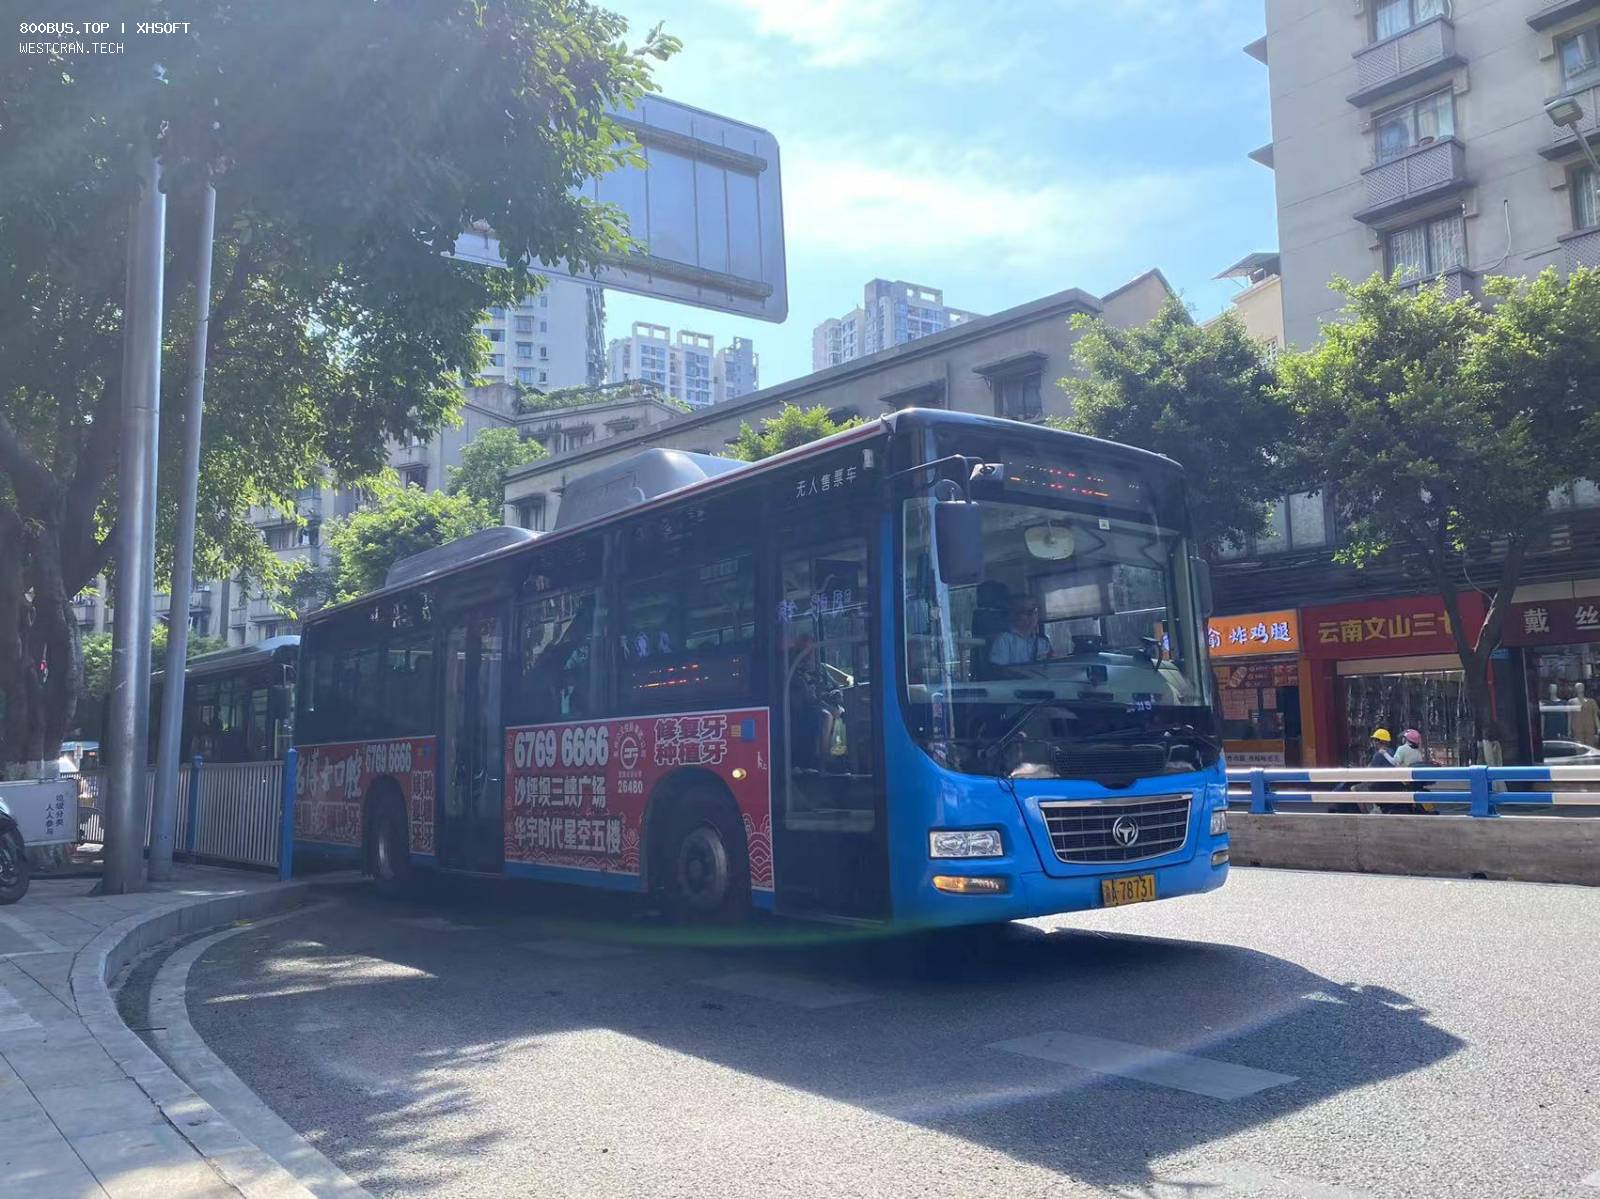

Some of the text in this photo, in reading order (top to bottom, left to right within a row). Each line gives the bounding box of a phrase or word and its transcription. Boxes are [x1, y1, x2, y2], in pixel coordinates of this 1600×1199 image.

[796, 466, 857, 498] 无人售票车
[654, 716, 728, 742] 修复牙
[514, 731, 557, 768] 6769
[561, 726, 609, 767] 6666
[654, 739, 728, 767] 种植牙
[514, 775, 607, 808] 沙坪坝三峡广场
[514, 816, 622, 854] 华宇时代星空五楼
